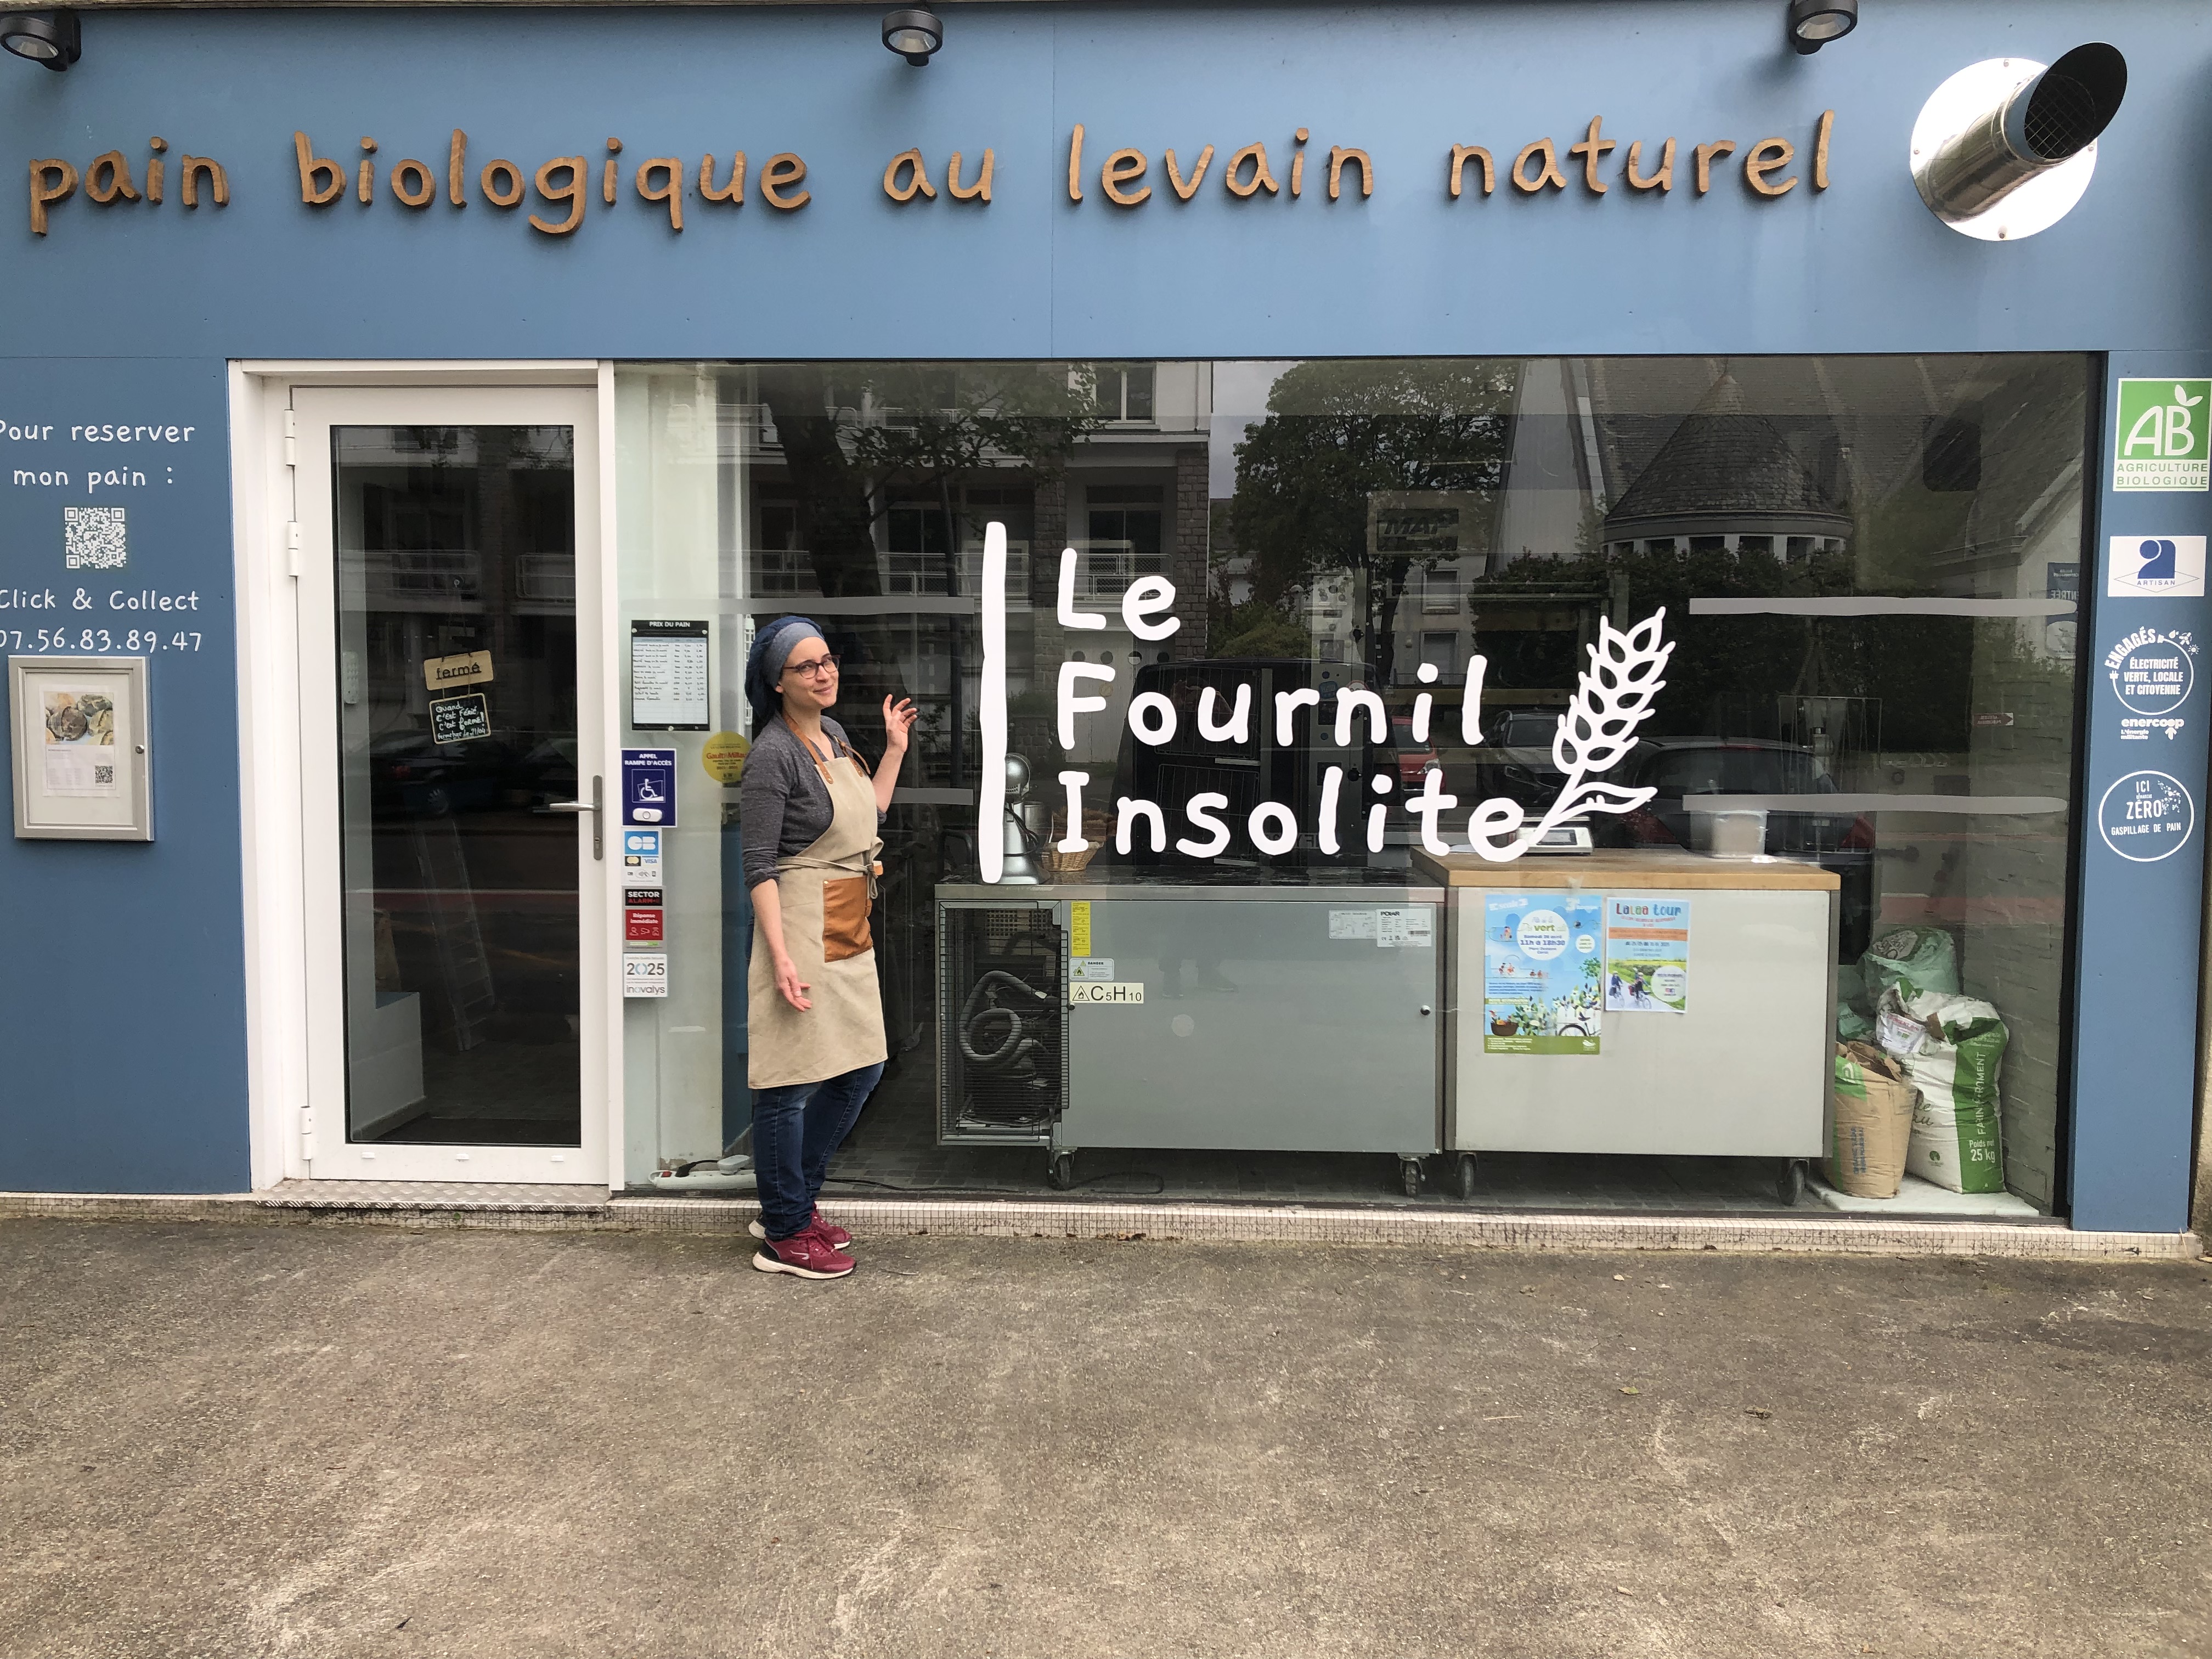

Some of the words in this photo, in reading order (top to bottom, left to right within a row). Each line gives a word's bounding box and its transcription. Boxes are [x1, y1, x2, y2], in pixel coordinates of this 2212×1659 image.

[30, 137, 229, 236] pain
[294, 128, 811, 237] biologique
[883, 148, 994, 204] au
[1068, 124, 1373, 207] levain
[1449, 110, 1833, 198] naturel
[72, 424, 195, 442] reserver
[2124, 405, 2194, 456] AB
[2117, 463, 2208, 472] AGRICULTURE
[14, 470, 69, 486] mon
[88, 466, 146, 494] pain
[2117, 476, 2208, 486] BIOLOGIQUE
[0, 588, 56, 610] Click
[72, 588, 93, 610] &
[109, 590, 199, 611] Collect
[1057, 548, 1181, 641] Le
[0, 627, 201, 653] 07.56.83.89.47
[2104, 625, 2156, 670] ENGAGÉS
[2129, 657, 2179, 669] ÉLECTRICITÉ
[436, 663, 482, 680] fermé
[2124, 672, 2151, 683] VERTE,
[2153, 672, 2183, 682] LOCALE
[2125, 685, 2135, 695] ET
[2137, 684, 2181, 695] CITOYENNE
[436, 701, 463, 713] Quand
[1057, 654, 1487, 750] Fournil
[2121, 719, 2185, 729] enercoop
[2136, 780, 2149, 793] ICI
[1057, 766, 1528, 862] Insolite
[2126, 799, 2162, 820] ZÉRO
[2111, 824, 2149, 836] GASPILLAGE
[2153, 823, 2162, 833] DE
[2166, 822, 2181, 832] PAIN
[1653, 904, 1681, 916] tour
[627, 962, 665, 975] 2025
[626, 985, 665, 995] inovalys
[1968, 1139, 1986, 1148] Poids
[1970, 1148, 1983, 1162] 25
[1985, 1148, 1996, 1164] kg
